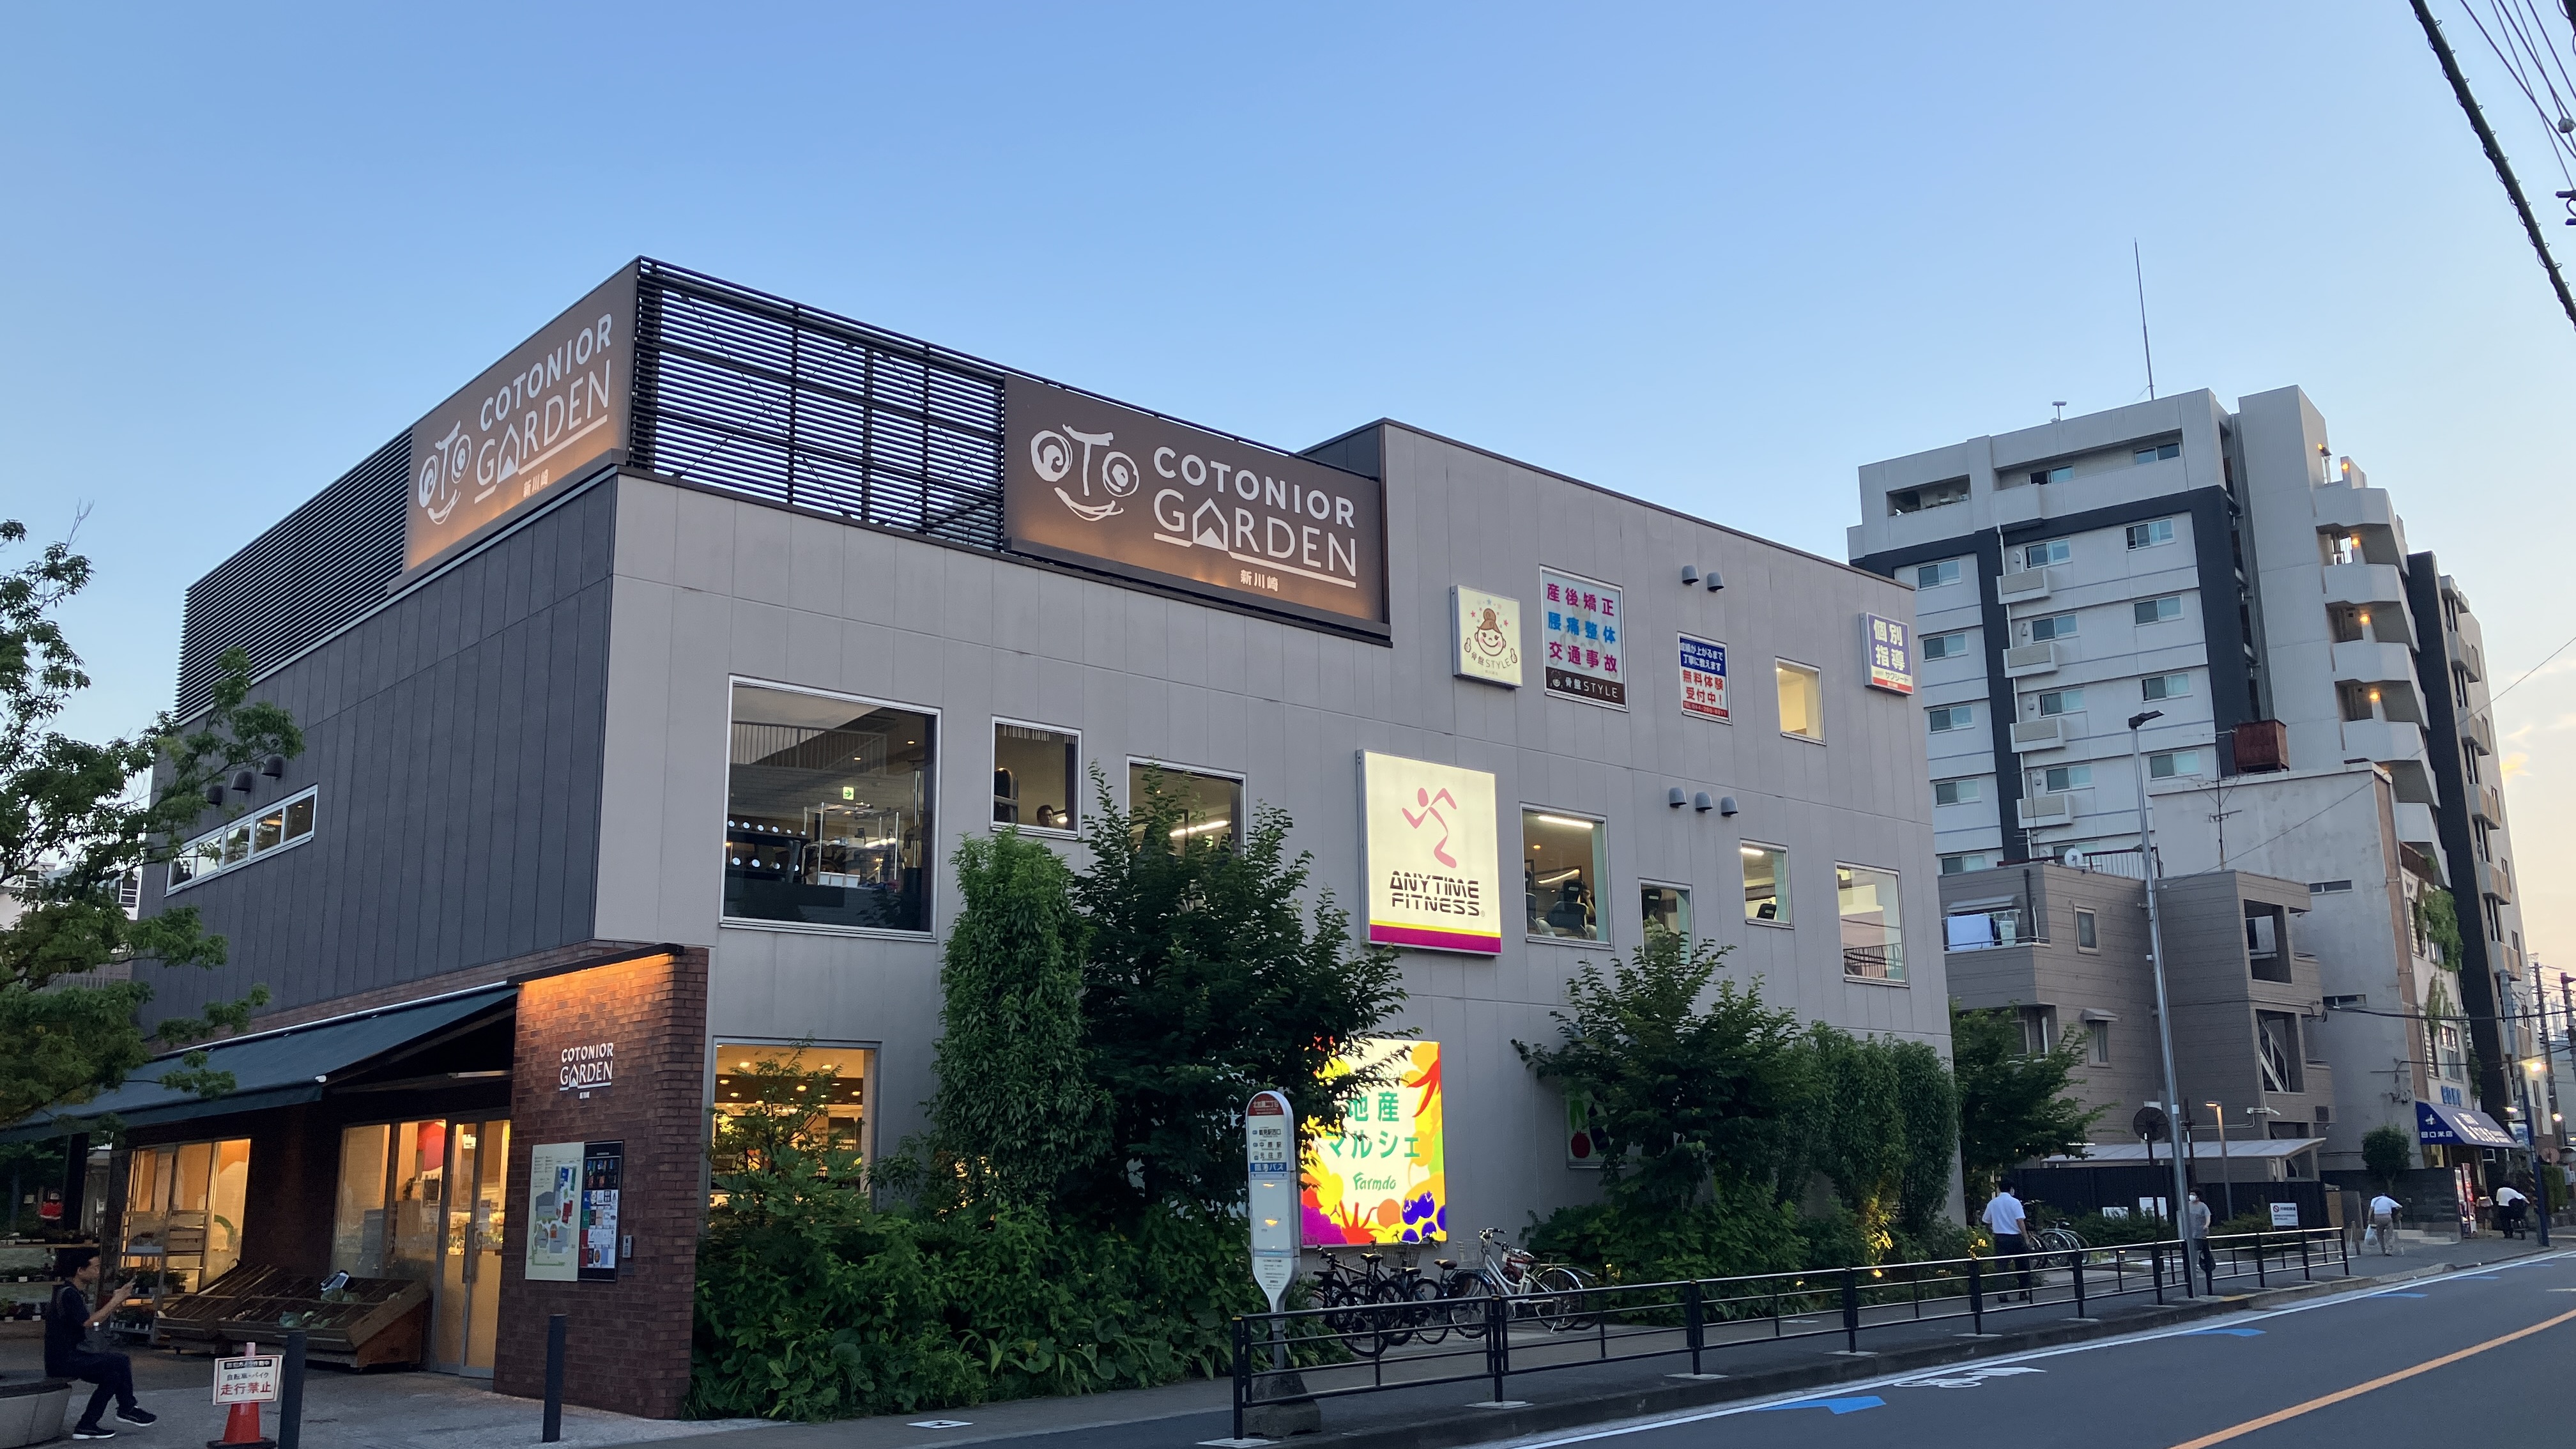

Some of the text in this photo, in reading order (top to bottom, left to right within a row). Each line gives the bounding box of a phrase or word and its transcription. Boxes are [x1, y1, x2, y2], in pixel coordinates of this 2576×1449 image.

[480, 313, 612, 432] COTONIOR
[477, 359, 611, 486] GARDEN
[523, 468, 549, 498] 新川崎
[1153, 447, 1356, 528] COTONIOR
[1153, 488, 1357, 577] GARDEN
[1239, 569, 1279, 592] 新川崎
[1547, 583, 1614, 617] 産後矯正
[1547, 611, 1616, 644] 腰痛整体
[1873, 618, 1903, 647] 個別
[1549, 641, 1618, 673] 交通事故
[1874, 643, 1905, 671] 指導
[1565, 676, 1618, 698] 骨盤STYLE
[1683, 669, 1724, 691] 無料体験
[1885, 671, 1909, 684] サクシード
[1389, 870, 1480, 899] ANYTIME
[1392, 892, 1480, 916] FITNESS
[561, 1042, 614, 1063] COTONIOR
[560, 1060, 613, 1088] GARDEN
[1346, 1091, 1400, 1122] 地産
[1325, 1129, 1421, 1160] マルシェ
[1352, 1171, 1397, 1192] Farmdo
[220, 1381, 272, 1397] 走行禁止
